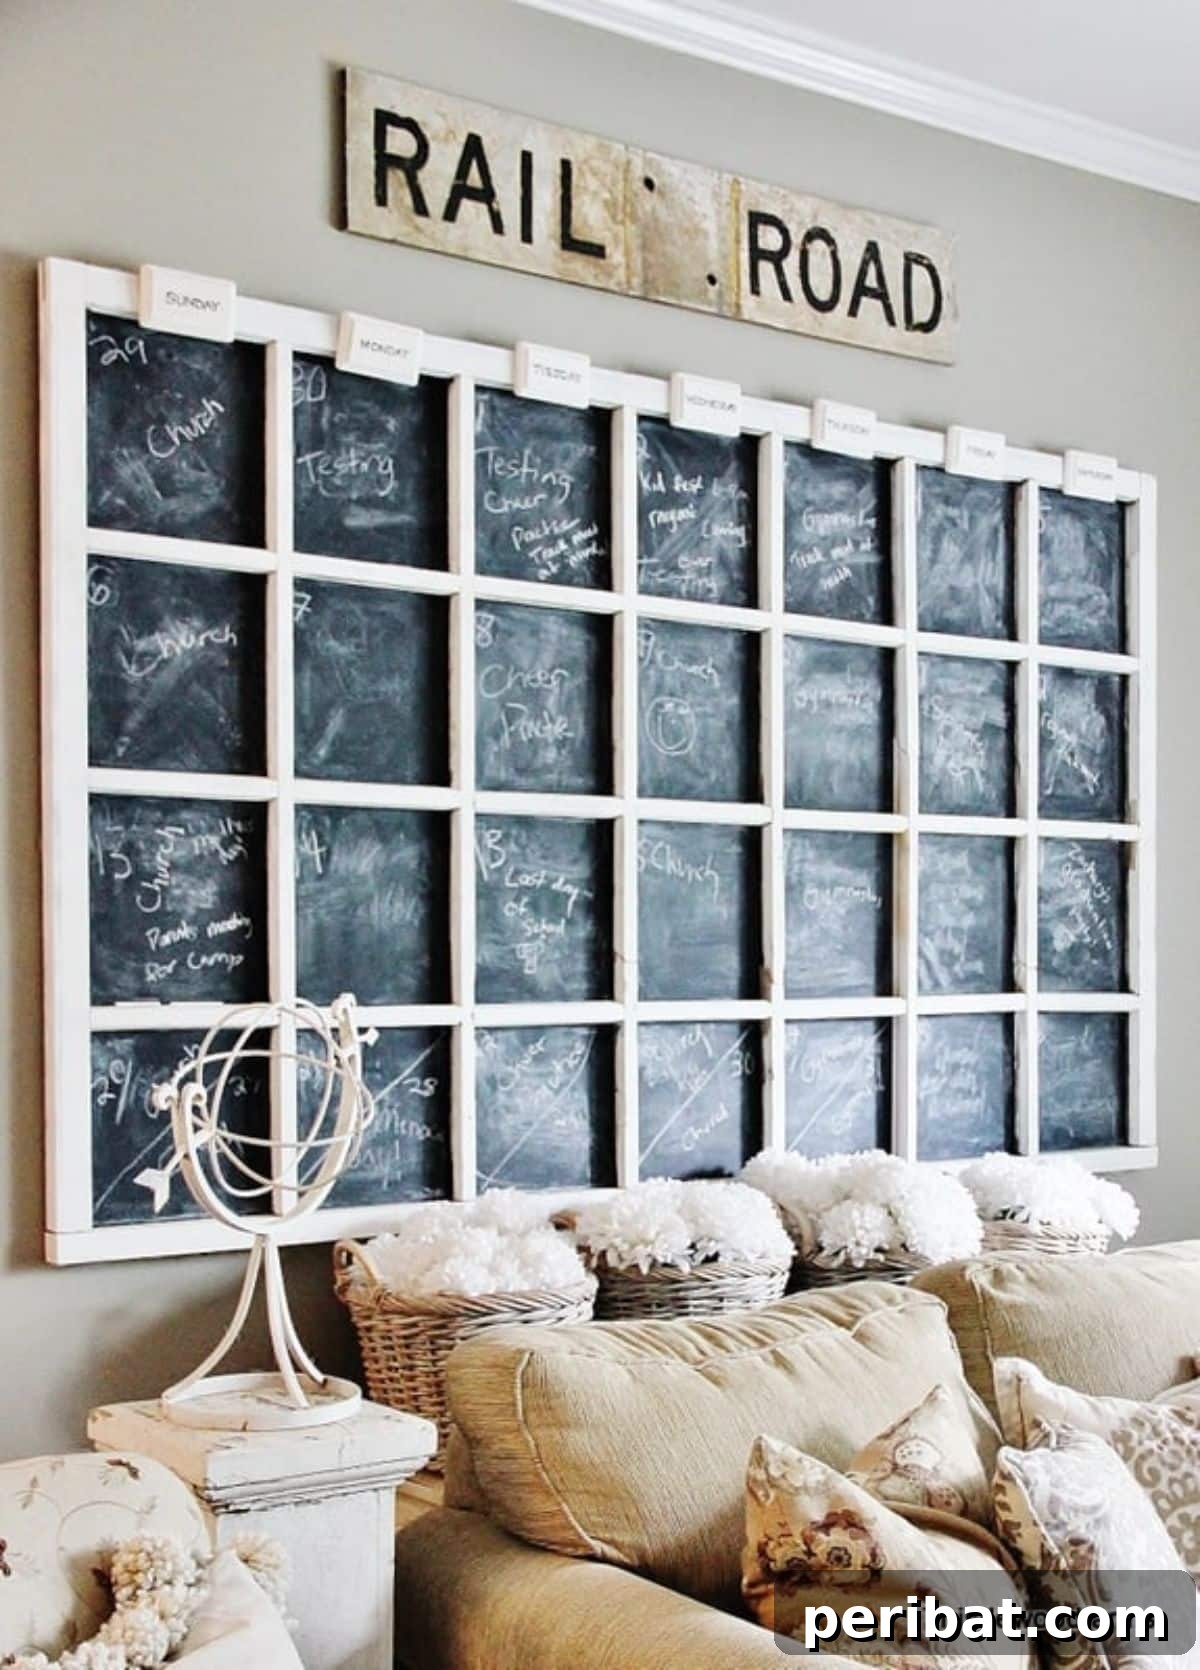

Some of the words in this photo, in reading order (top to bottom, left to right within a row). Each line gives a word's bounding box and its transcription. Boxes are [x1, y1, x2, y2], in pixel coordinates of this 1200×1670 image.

[373, 108, 607, 260] RAIL
[747, 210, 944, 334] ROAD
[165, 289, 222, 313] SUNDAY
[87, 335, 148, 367] 29
[359, 338, 410, 358] MONDAY
[146, 398, 225, 459] Church
[295, 448, 396, 497] Testing
[474, 446, 576, 504] Testing
